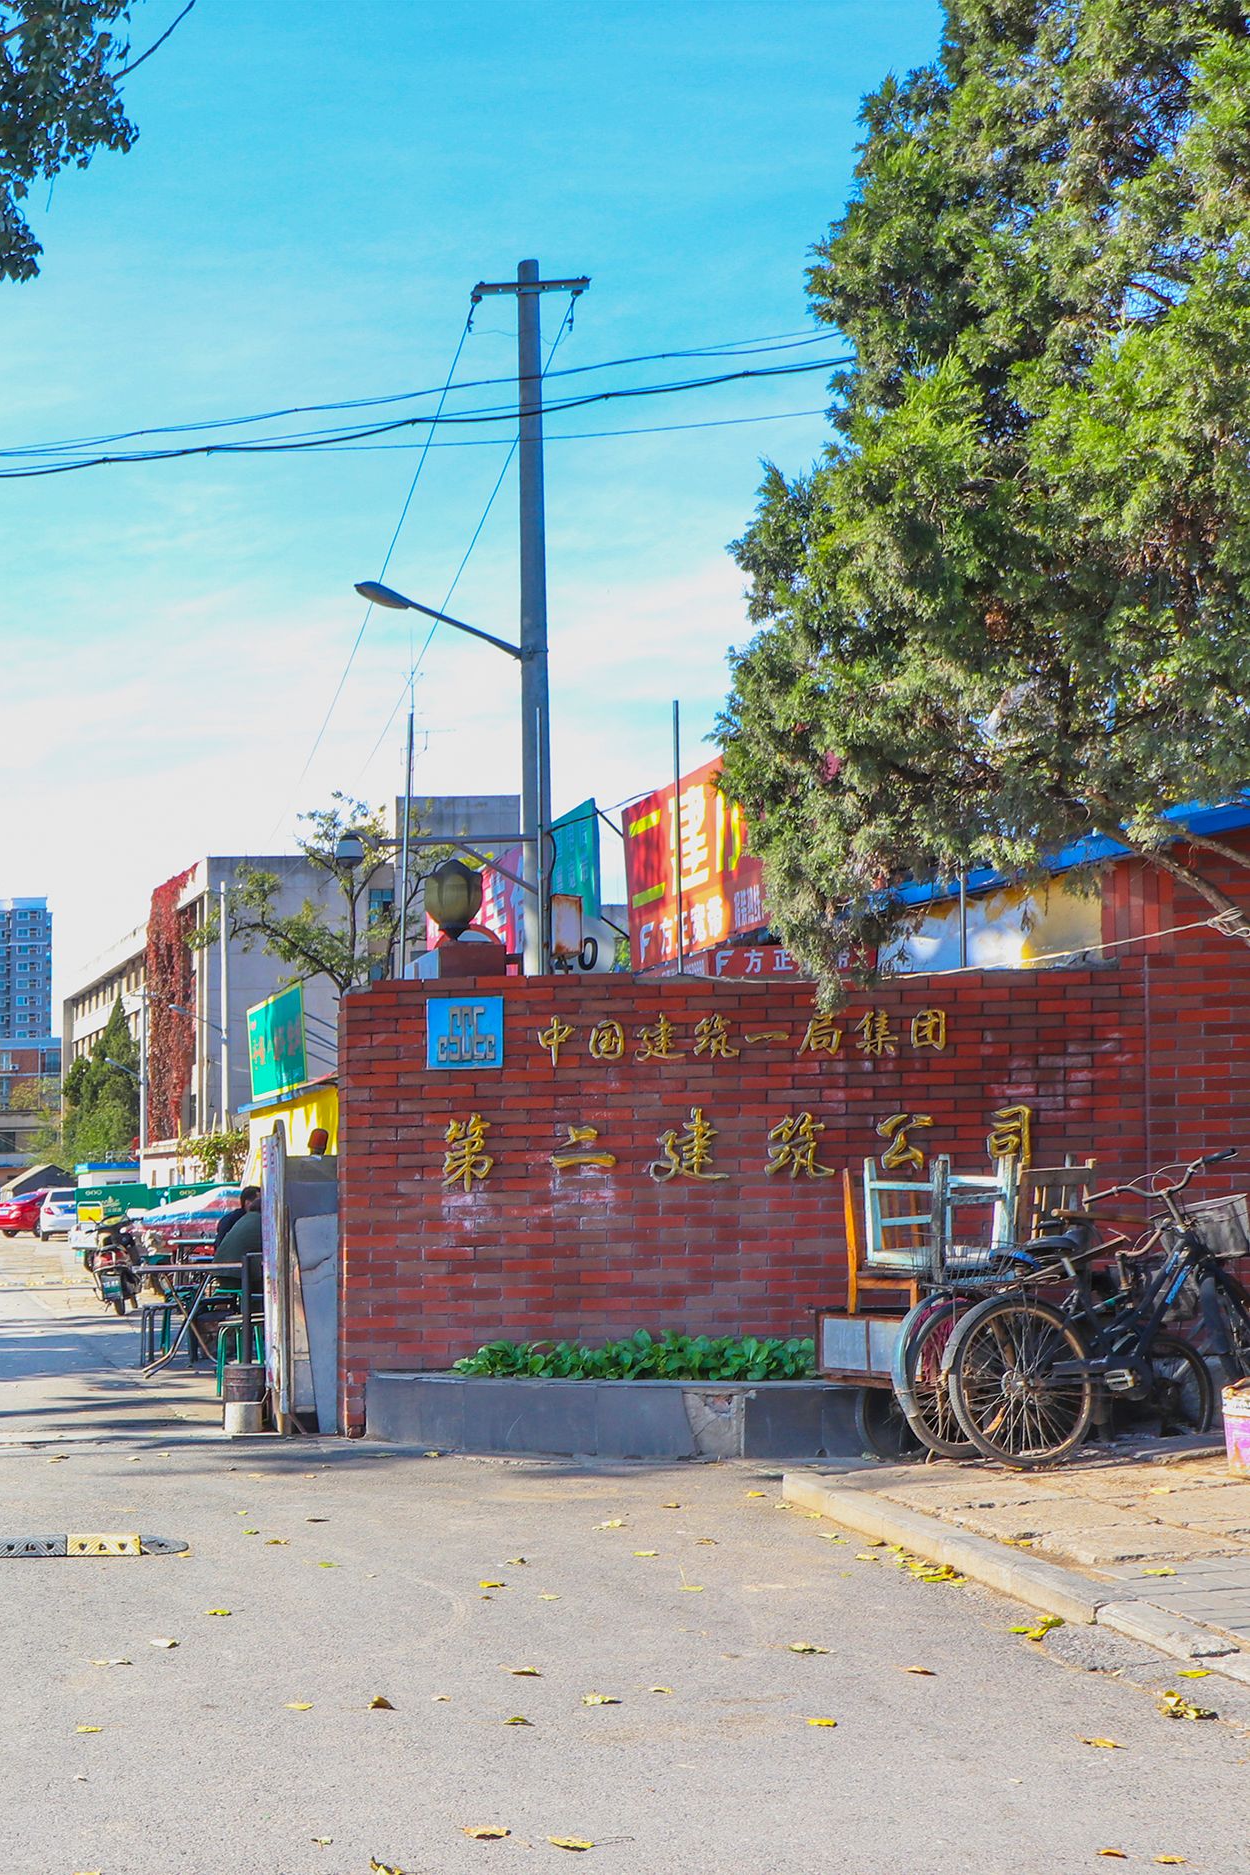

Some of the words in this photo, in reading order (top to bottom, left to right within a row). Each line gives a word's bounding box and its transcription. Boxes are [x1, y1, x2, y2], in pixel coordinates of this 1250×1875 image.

[537, 1009, 947, 1068] 中国建筑一局集团
[442, 1105, 1032, 1192] 第二建筑公司
